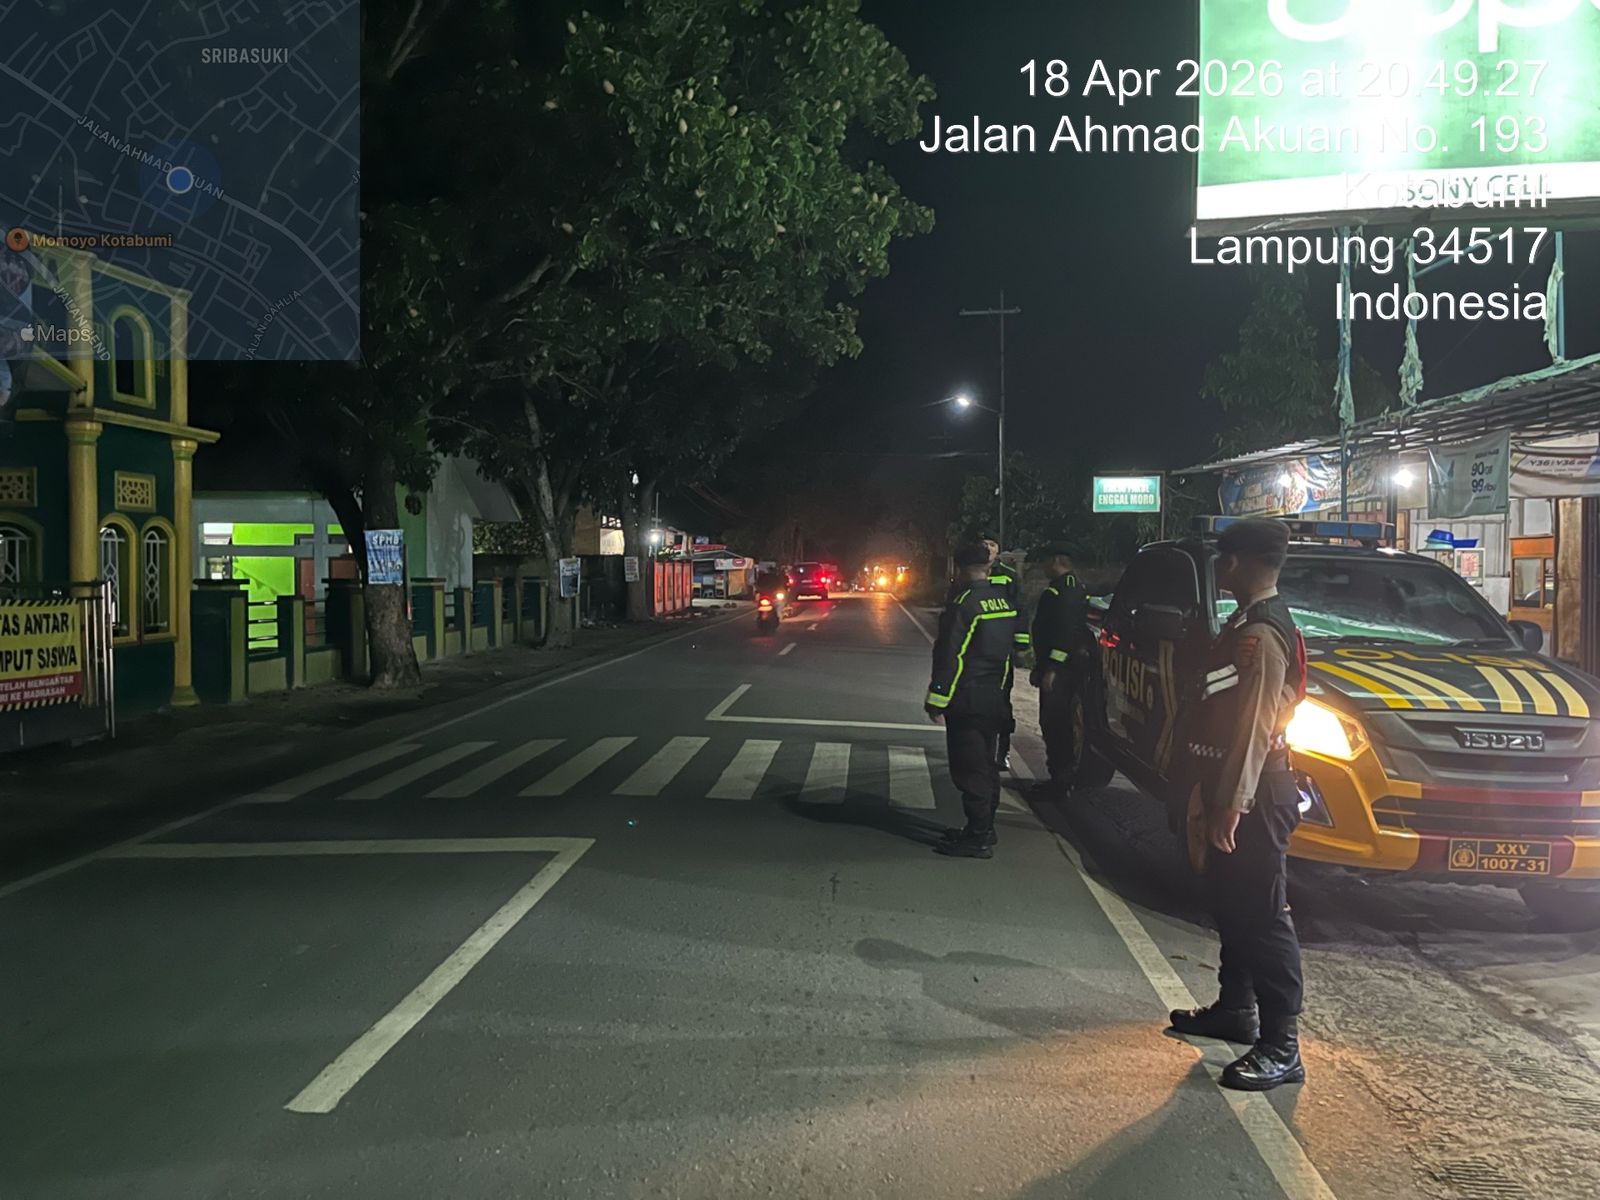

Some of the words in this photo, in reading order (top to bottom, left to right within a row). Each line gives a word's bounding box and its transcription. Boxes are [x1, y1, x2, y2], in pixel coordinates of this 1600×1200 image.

[1098, 494, 1129, 505] ENGGAL
[24, 612, 69, 636] ANTAR
[38, 645, 78, 669] SISWA
[1462, 731, 1544, 751] ISUZU
[1495, 842, 1530, 856] XXV
[1480, 857, 1547, 873] 1007-31
